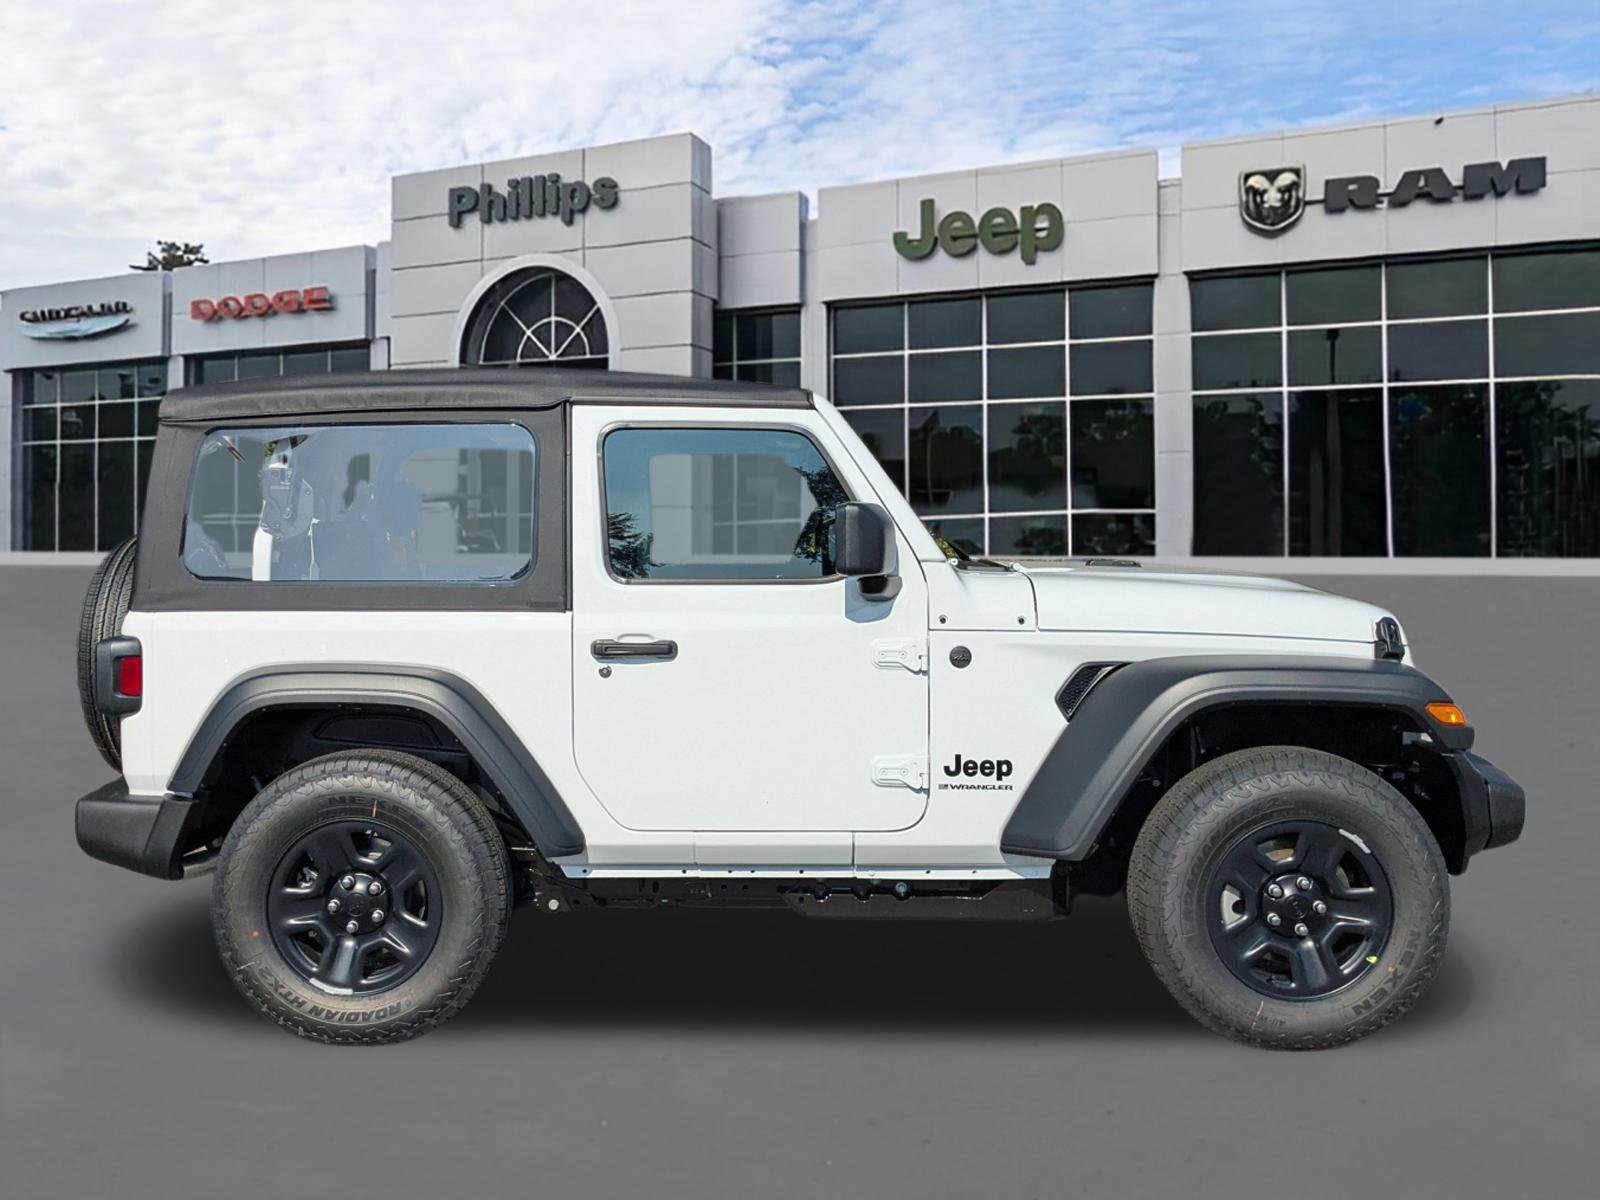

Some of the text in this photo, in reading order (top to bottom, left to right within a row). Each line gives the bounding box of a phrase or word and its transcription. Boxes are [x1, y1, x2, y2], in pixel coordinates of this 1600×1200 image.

[448, 172, 619, 229] Phillips
[1324, 156, 1547, 213] RAM
[893, 198, 1064, 266] Jeep
[190, 286, 334, 322] DODGE
[943, 753, 1013, 781] Jeep
